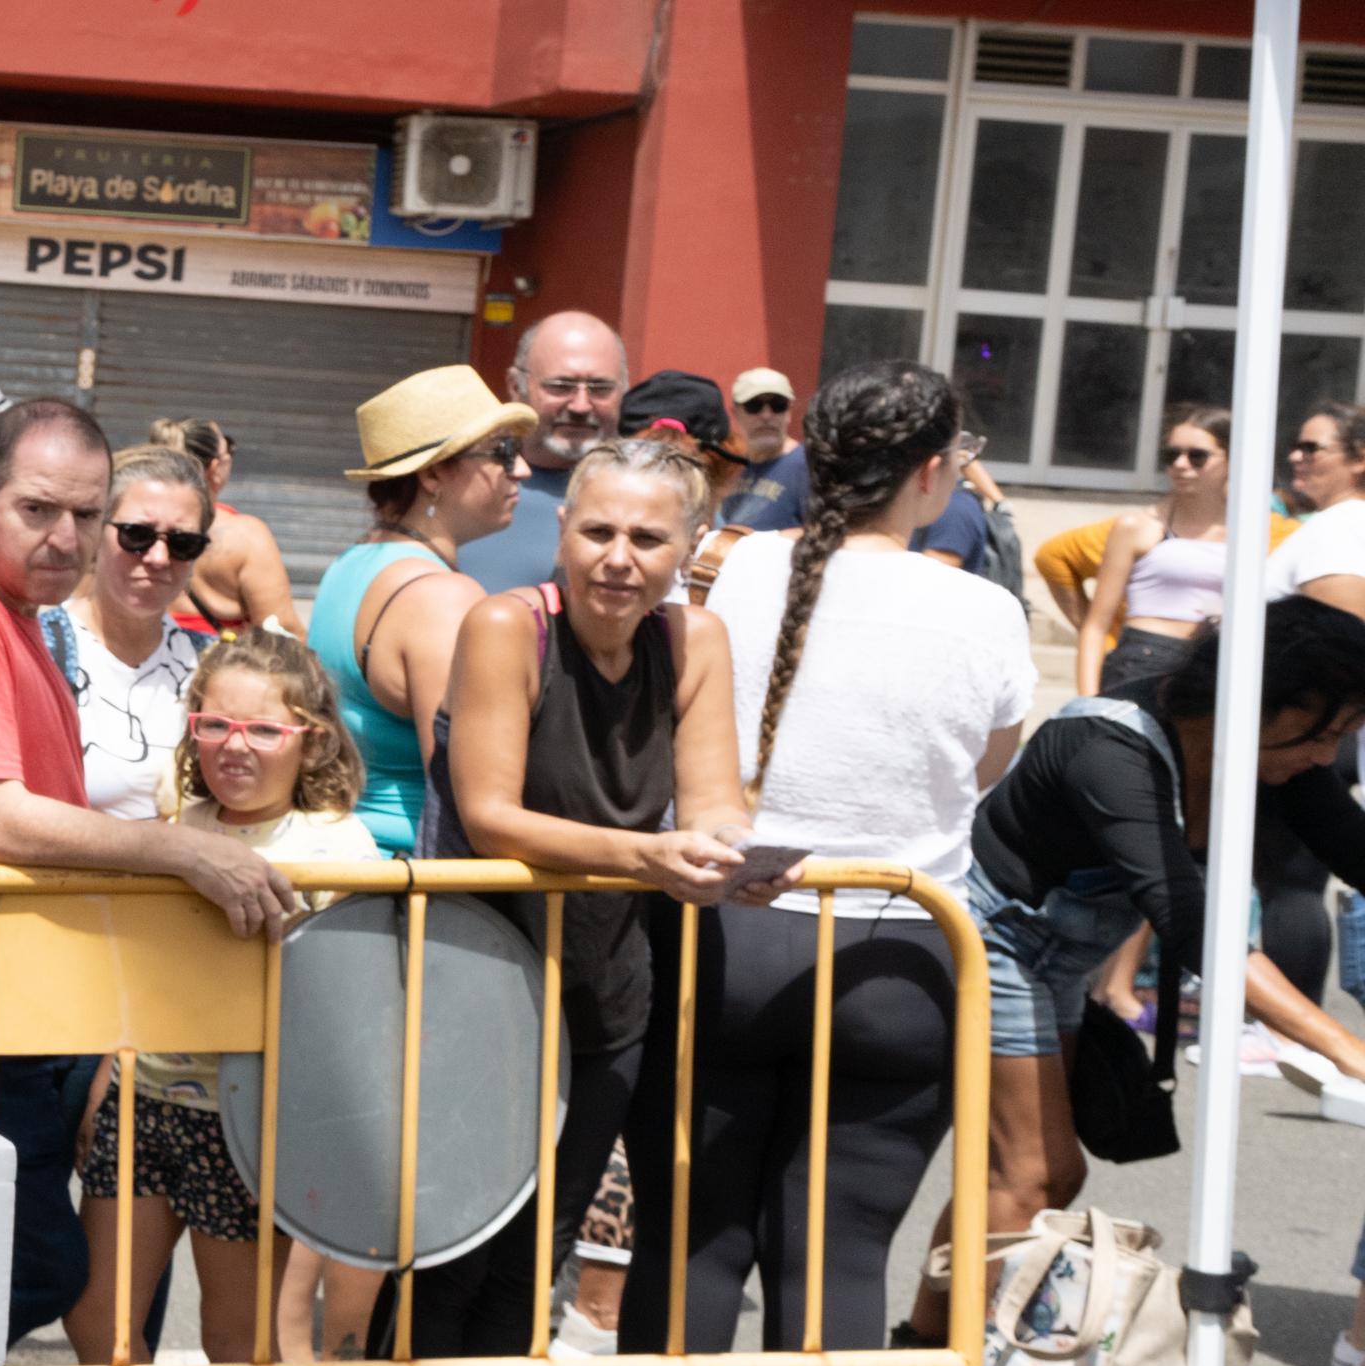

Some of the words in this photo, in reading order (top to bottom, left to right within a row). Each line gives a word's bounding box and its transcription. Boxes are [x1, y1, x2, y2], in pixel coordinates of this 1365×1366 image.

[29, 168, 99, 202] Playa
[104, 174, 136, 199] de
[26, 236, 187, 282] PEPSI
[230, 270, 287, 290] ABRIMOS
[353, 279, 362, 295] Y
[363, 278, 431, 299] DOMINGOS
